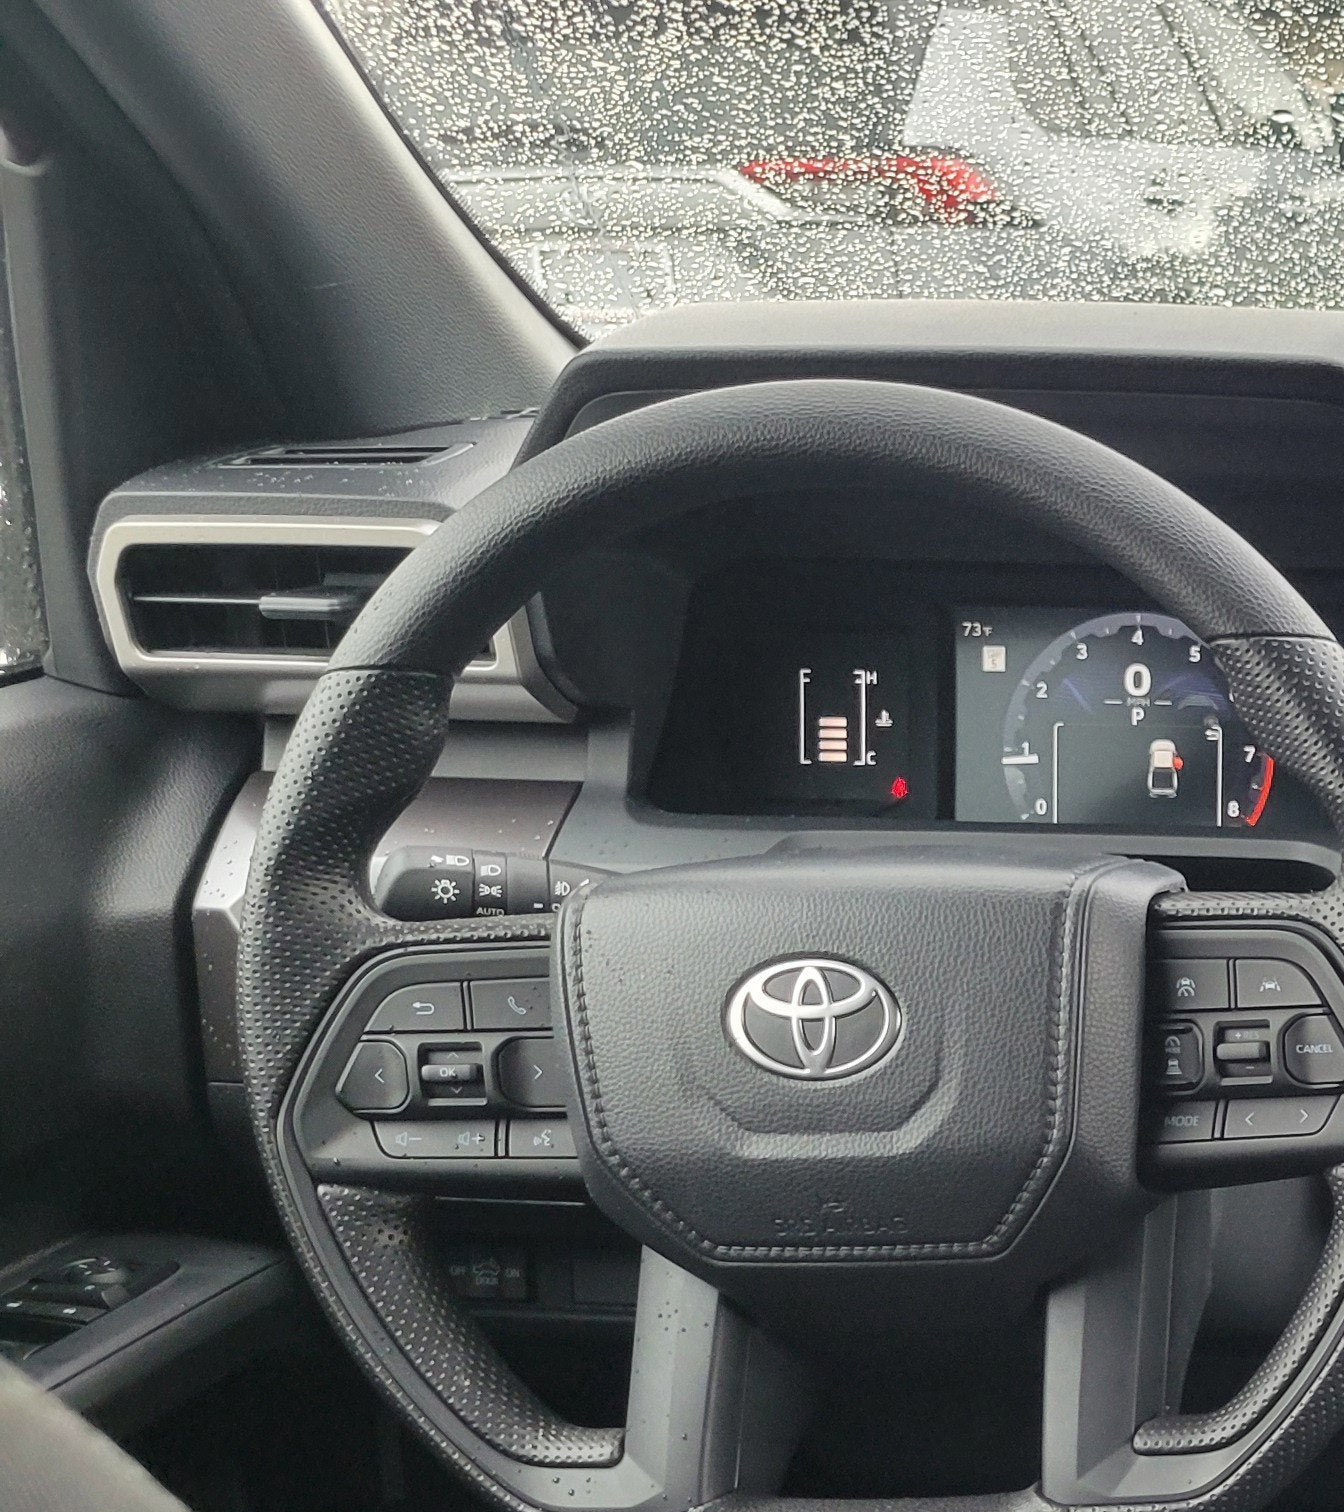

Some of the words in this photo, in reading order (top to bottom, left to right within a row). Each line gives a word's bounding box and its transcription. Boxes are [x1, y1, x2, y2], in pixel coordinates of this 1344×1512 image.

[1131, 629, 1144, 646] 4
[1076, 642, 1088, 660] 3
[1189, 645, 1201, 662] 5
[865, 671, 877, 685] H
[1124, 663, 1151, 697] 0
[1036, 681, 1048, 698] 2
[1131, 706, 1144, 726] P
[865, 751, 876, 765] C
[1243, 746, 1256, 763] 7
[1035, 798, 1047, 815] 0
[1227, 800, 1240, 817] 8
[476, 906, 505, 917] AUTO
[1296, 1044, 1334, 1054] CANCEL
[439, 1066, 456, 1078] OK
[1164, 1115, 1199, 1127] MODE
